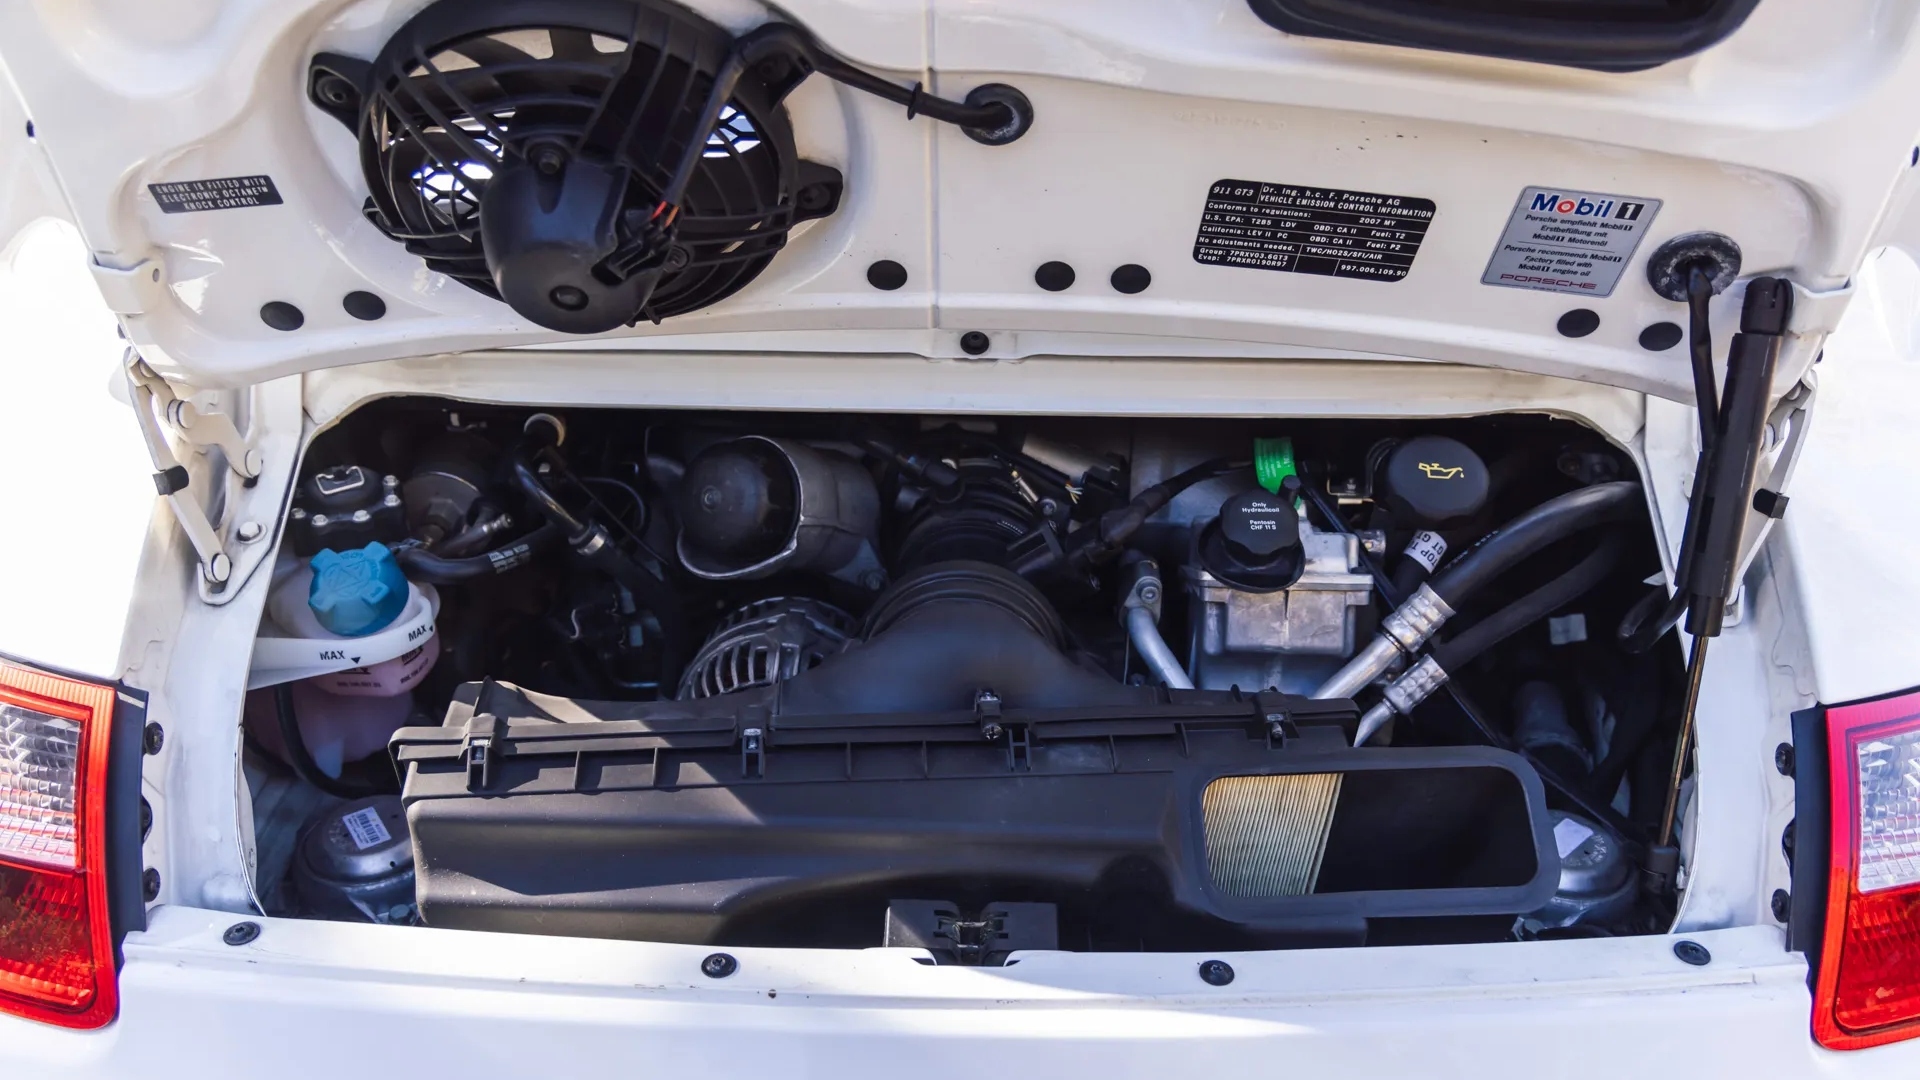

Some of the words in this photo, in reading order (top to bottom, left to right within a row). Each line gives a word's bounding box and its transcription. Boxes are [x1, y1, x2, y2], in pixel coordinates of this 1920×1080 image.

[156, 184, 191, 194] ENGINE
[193, 183, 204, 191] IS
[207, 179, 240, 190] FITTED
[242, 177, 266, 187] WITH
[1213, 186, 1231, 195] 911
[1235, 188, 1254, 197] GT3
[162, 190, 220, 203] ELECTRONIC
[1263, 186, 1277, 194] Dr.
[1282, 188, 1300, 197] Ing.
[1305, 190, 1324, 199] h.c.
[1329, 192, 1338, 200] F.
[1343, 193, 1383, 204] Porsche
[1386, 198, 1401, 206] AG
[183, 200, 214, 210] KNOCK
[217, 197, 260, 208] CONTROL
[1260, 195, 1292, 204] VEHICLE
[1296, 197, 1335, 209] EMISSION
[1338, 202, 1374, 213] CONTROL
[1378, 206, 1432, 218] INFORMATION
[1530, 193, 1614, 218] Mobil
[1208, 202, 1246, 212] Conforms
[1262, 208, 1311, 218] regulations:
[1359, 217, 1381, 225] 2007
[1225, 215, 1244, 223] EPA:
[1314, 224, 1334, 232] OBD:
[1371, 230, 1391, 238] Fuel:
[1525, 214, 1558, 224] Porsche
[1560, 218, 1597, 228] empfiehlt
[1202, 226, 1244, 235] California:
[1310, 235, 1330, 243] OBD:
[1366, 241, 1387, 250] Fuel:
[1540, 225, 1592, 238] Erstbefüllung
[1212, 238, 1260, 248] adjustments
[1263, 243, 1295, 252] needed.
[1567, 237, 1608, 247] Motorenöl
[1198, 254, 1220, 262] Evap:
[1200, 247, 1226, 256] Group:
[1504, 244, 1536, 254] Porsche
[1538, 249, 1588, 260] recommends
[1524, 255, 1554, 265] Factory
[1556, 258, 1575, 267] filled
[1576, 261, 1592, 269] with
[1341, 264, 1406, 277] 997.006.109.90
[1552, 268, 1578, 277] engine
[1500, 273, 1597, 290] PORSCHE
[1420, 549, 1438, 566] TOP
[408, 624, 427, 642] MAX
[319, 650, 346, 661] MAX
